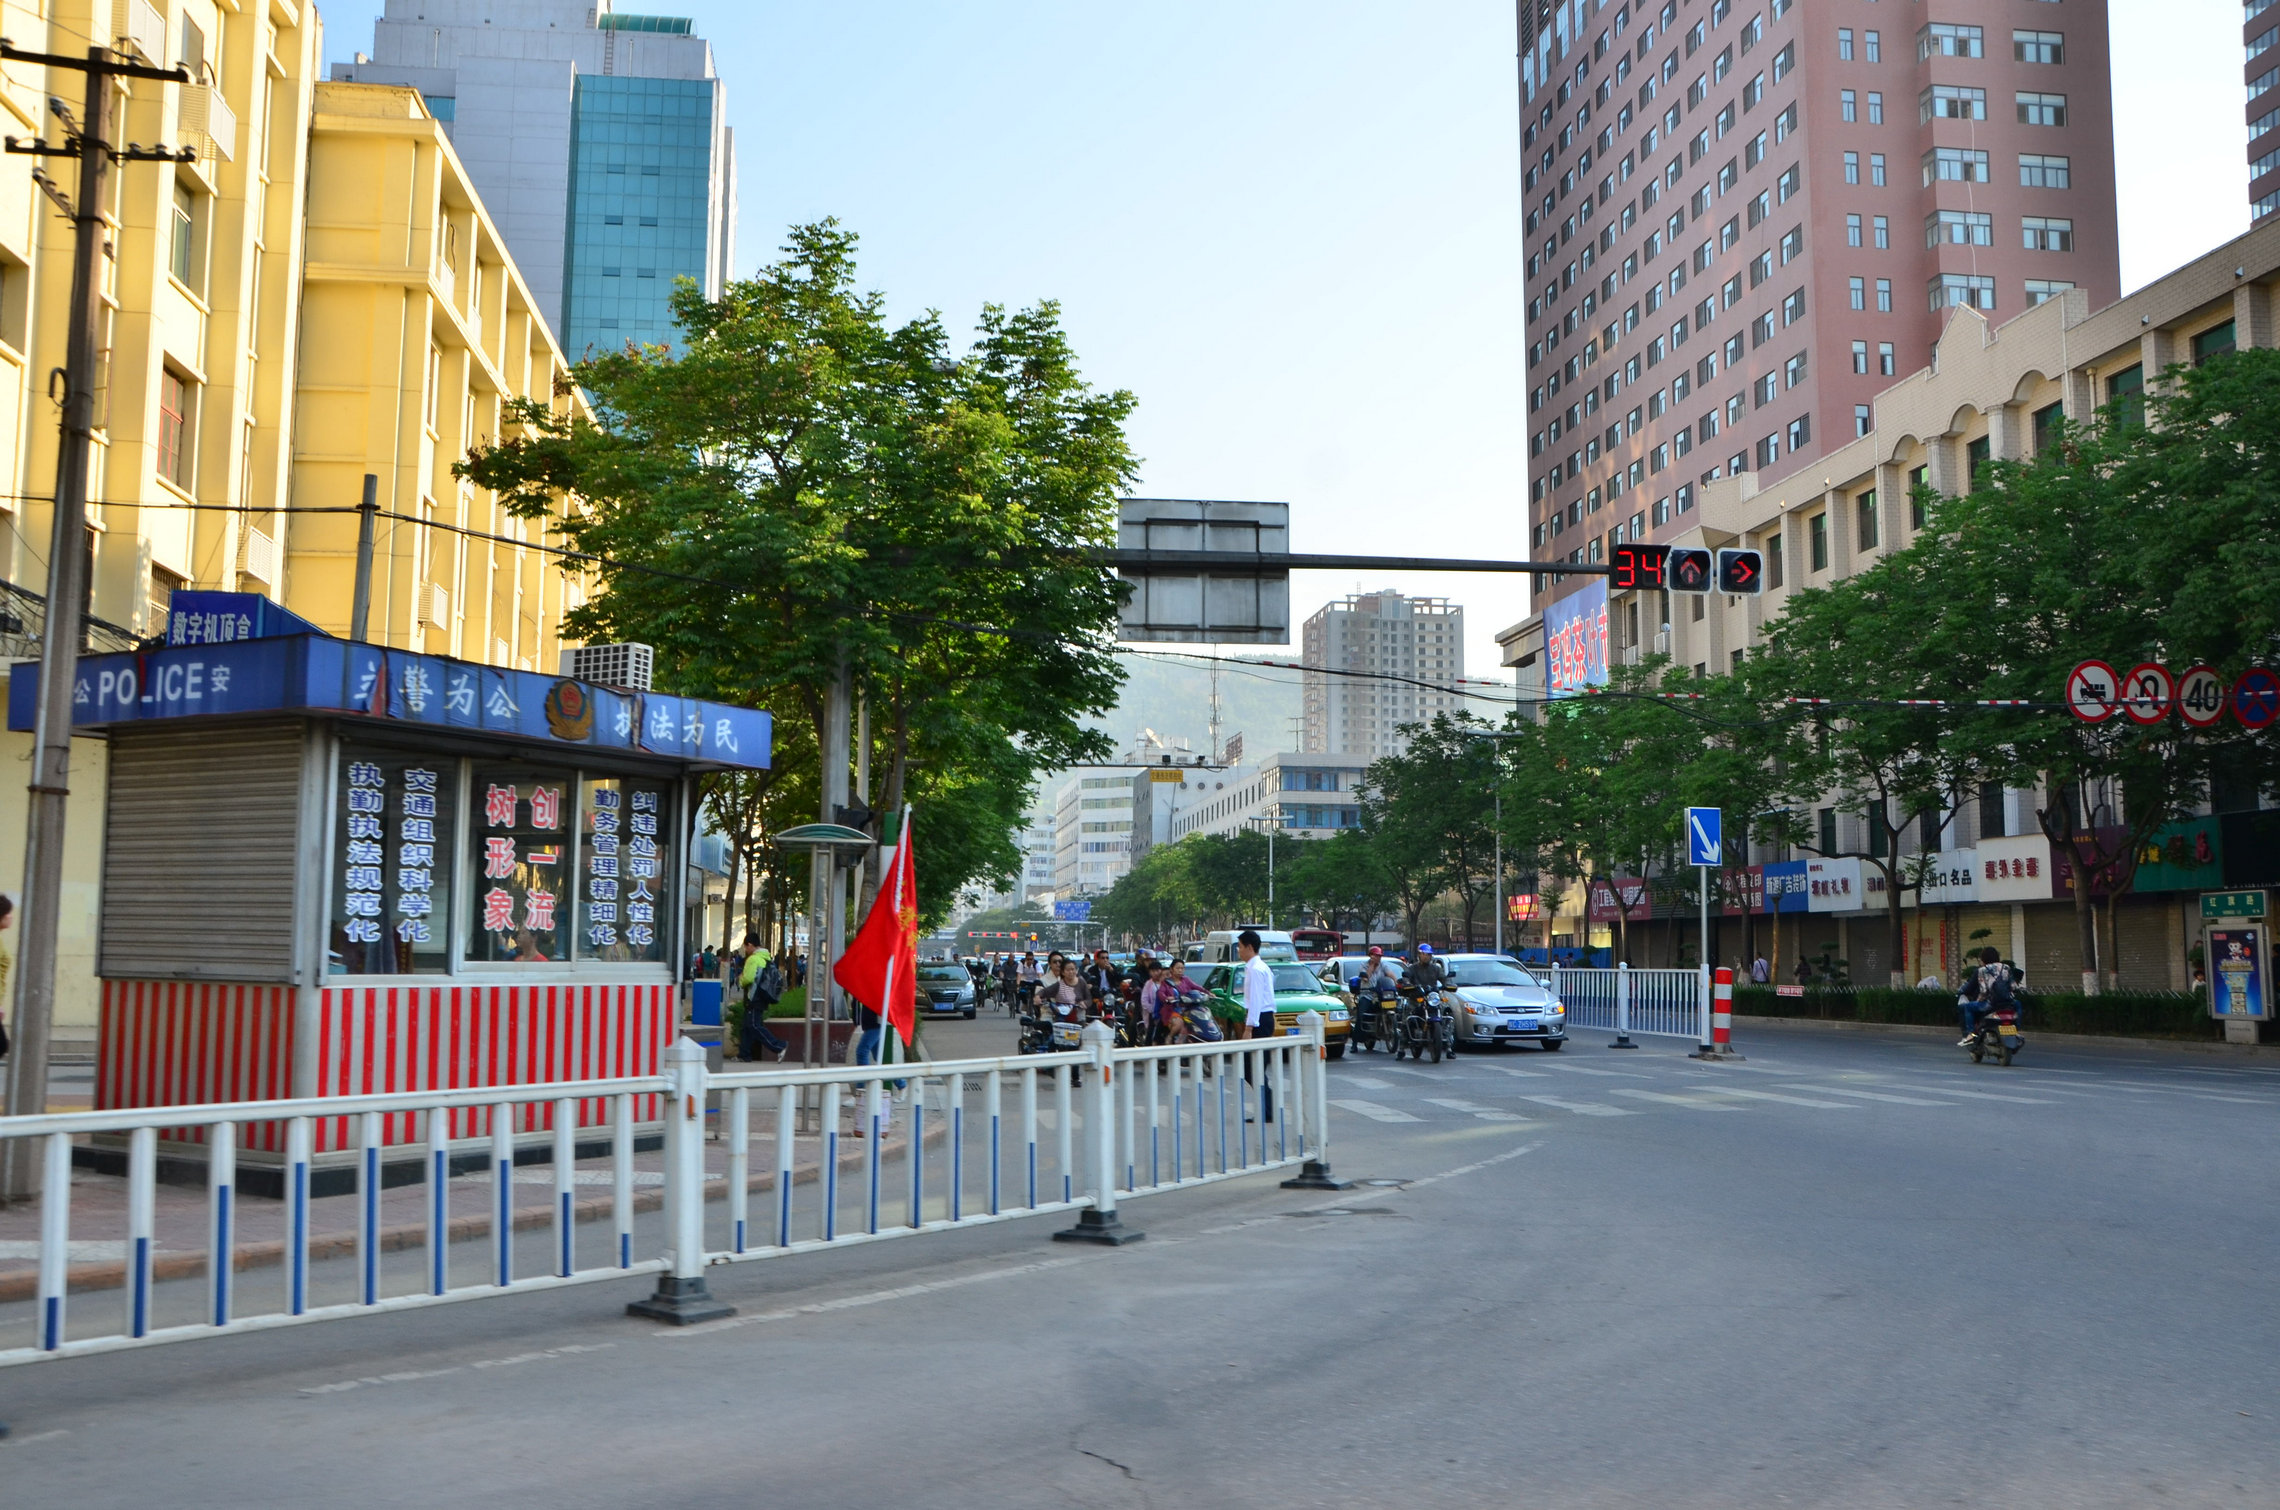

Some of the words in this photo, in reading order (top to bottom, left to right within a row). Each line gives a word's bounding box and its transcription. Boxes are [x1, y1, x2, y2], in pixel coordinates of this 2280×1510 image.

[172, 612, 251, 644] 数字机顶盒
[1617, 551, 1662, 587] 34
[211, 665, 230, 692] 安
[2186, 678, 2218, 713] 40
[344, 762, 385, 943] 执勤执法规范化
[397, 768, 438, 943] 交通组织科学化
[484, 783, 518, 932] 树形象
[525, 785, 560, 932] 创一流
[588, 788, 620, 946] 勤务管理精细化
[626, 791, 658, 945] 纠违处罚人性化
